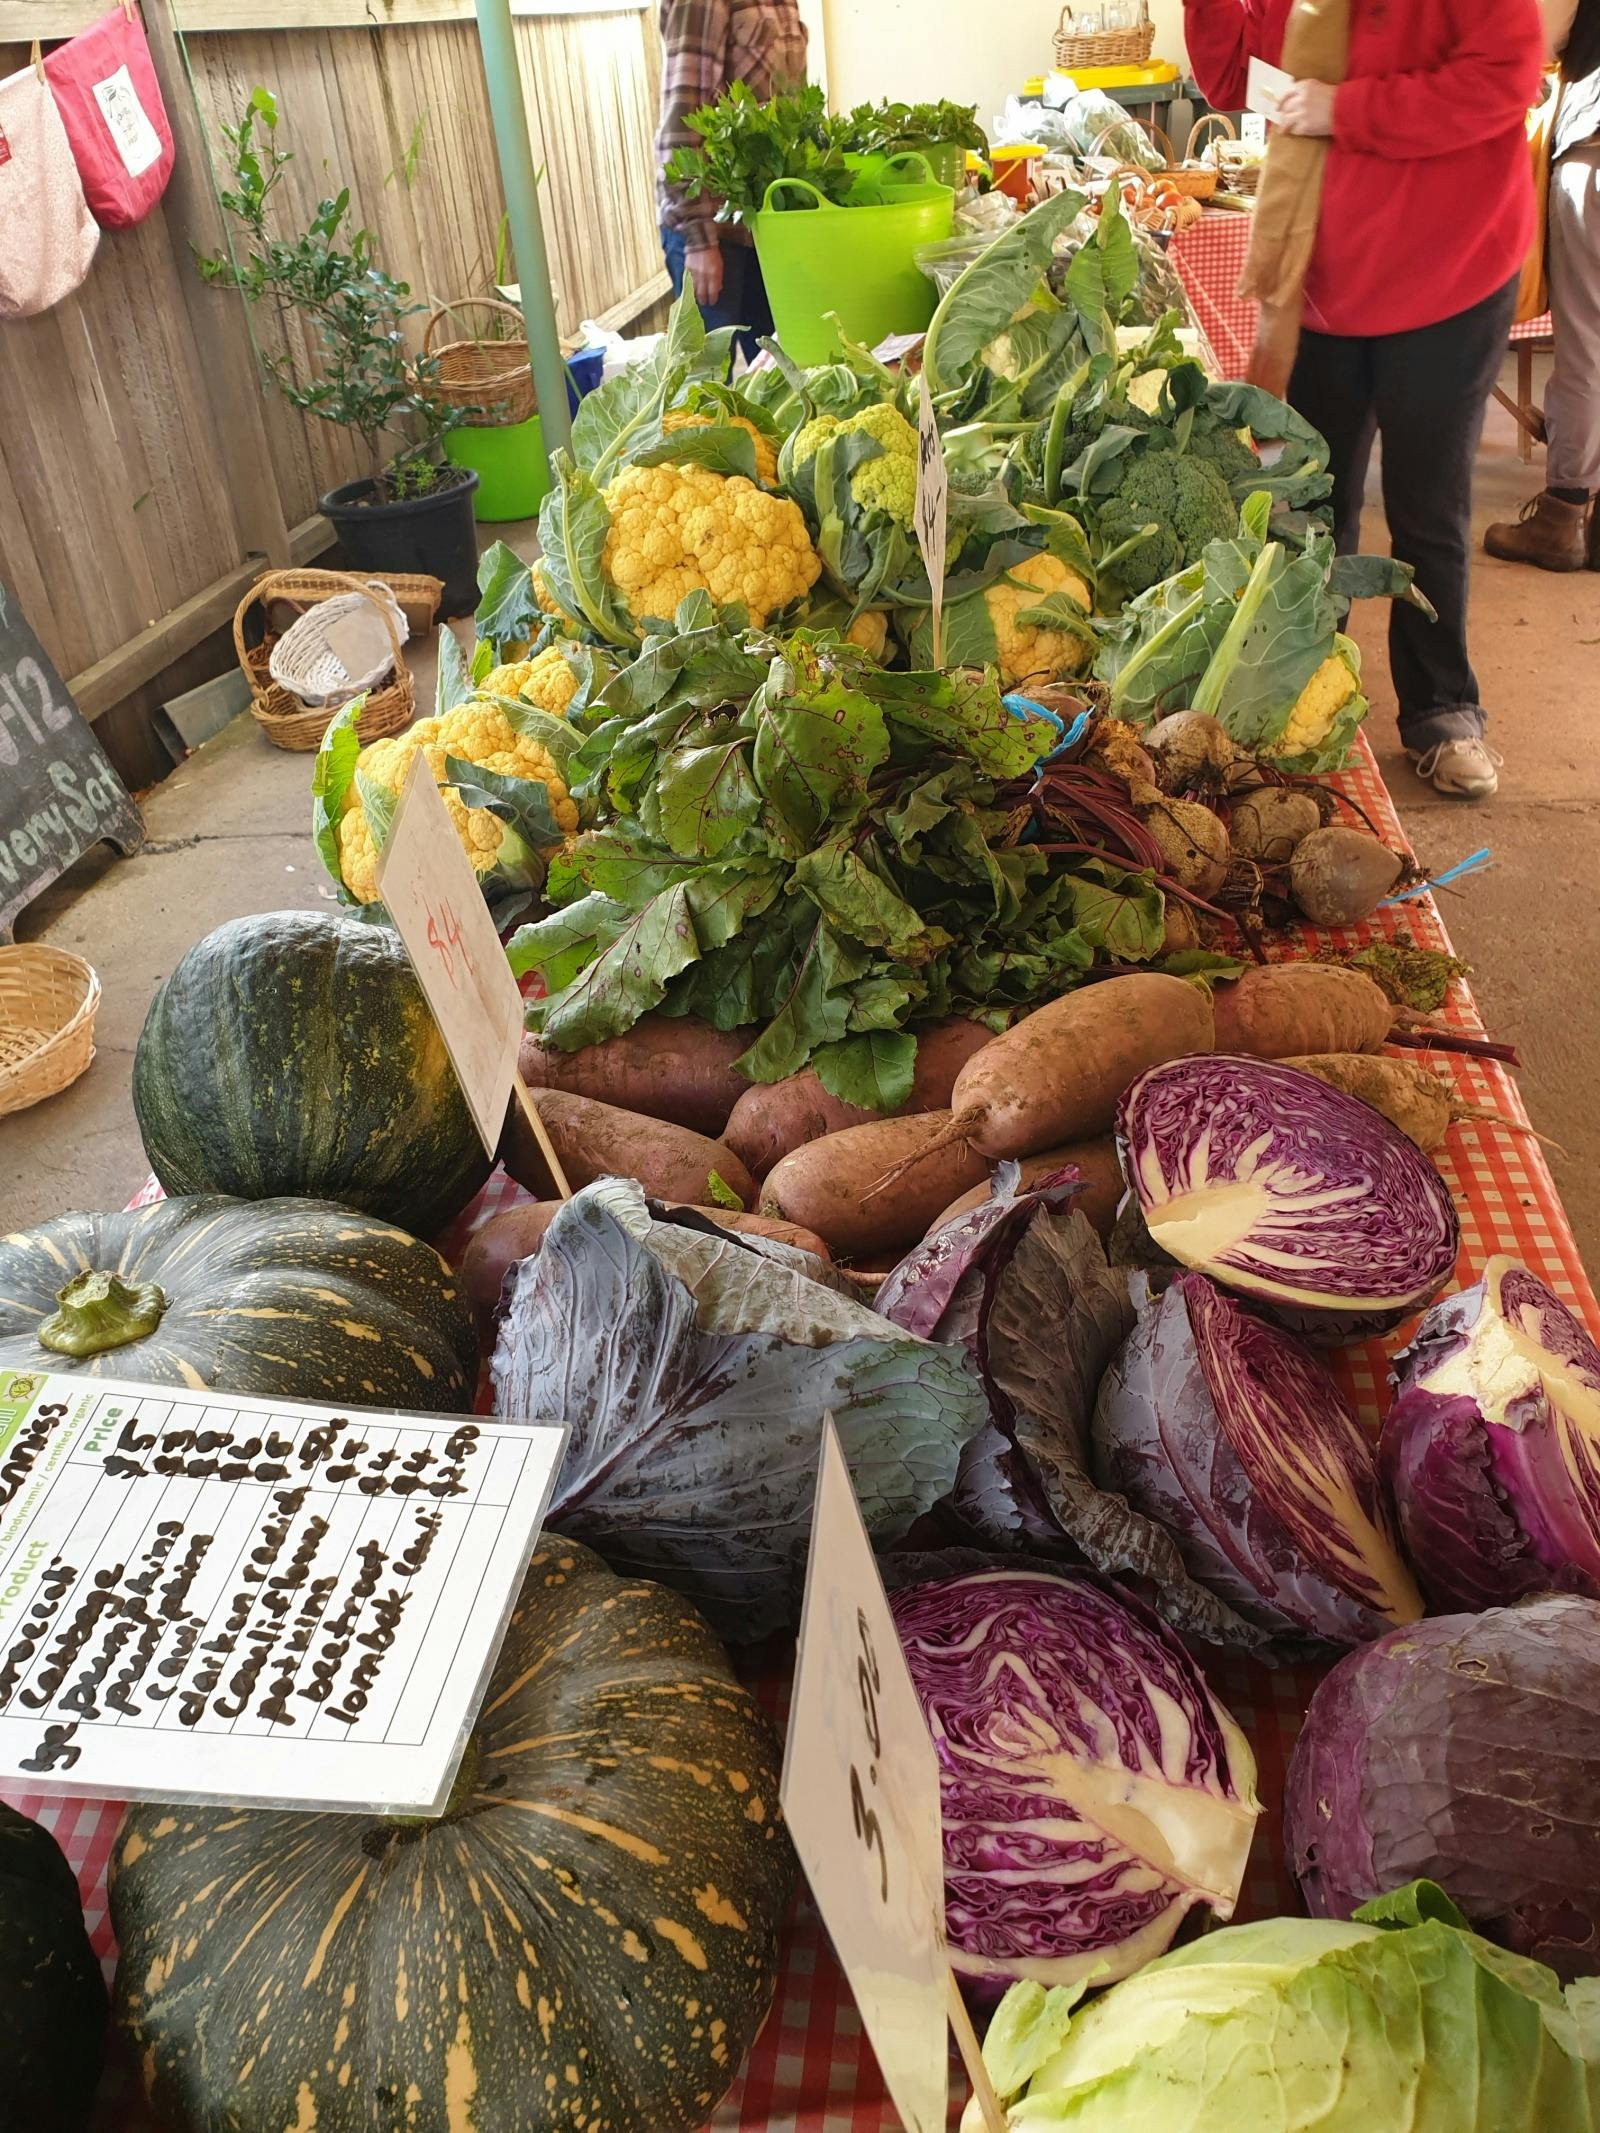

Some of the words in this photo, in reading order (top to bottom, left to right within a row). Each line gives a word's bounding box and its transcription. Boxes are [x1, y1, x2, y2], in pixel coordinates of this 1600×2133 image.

[0, 803, 81, 890] very
[47, 752, 126, 833] Sat
[421, 896, 475, 989] $4
[3, 1481, 44, 1541] biodynamic
[45, 1428, 72, 1473] certified
[69, 1393, 94, 1429] organic
[84, 1407, 123, 1453] Price
